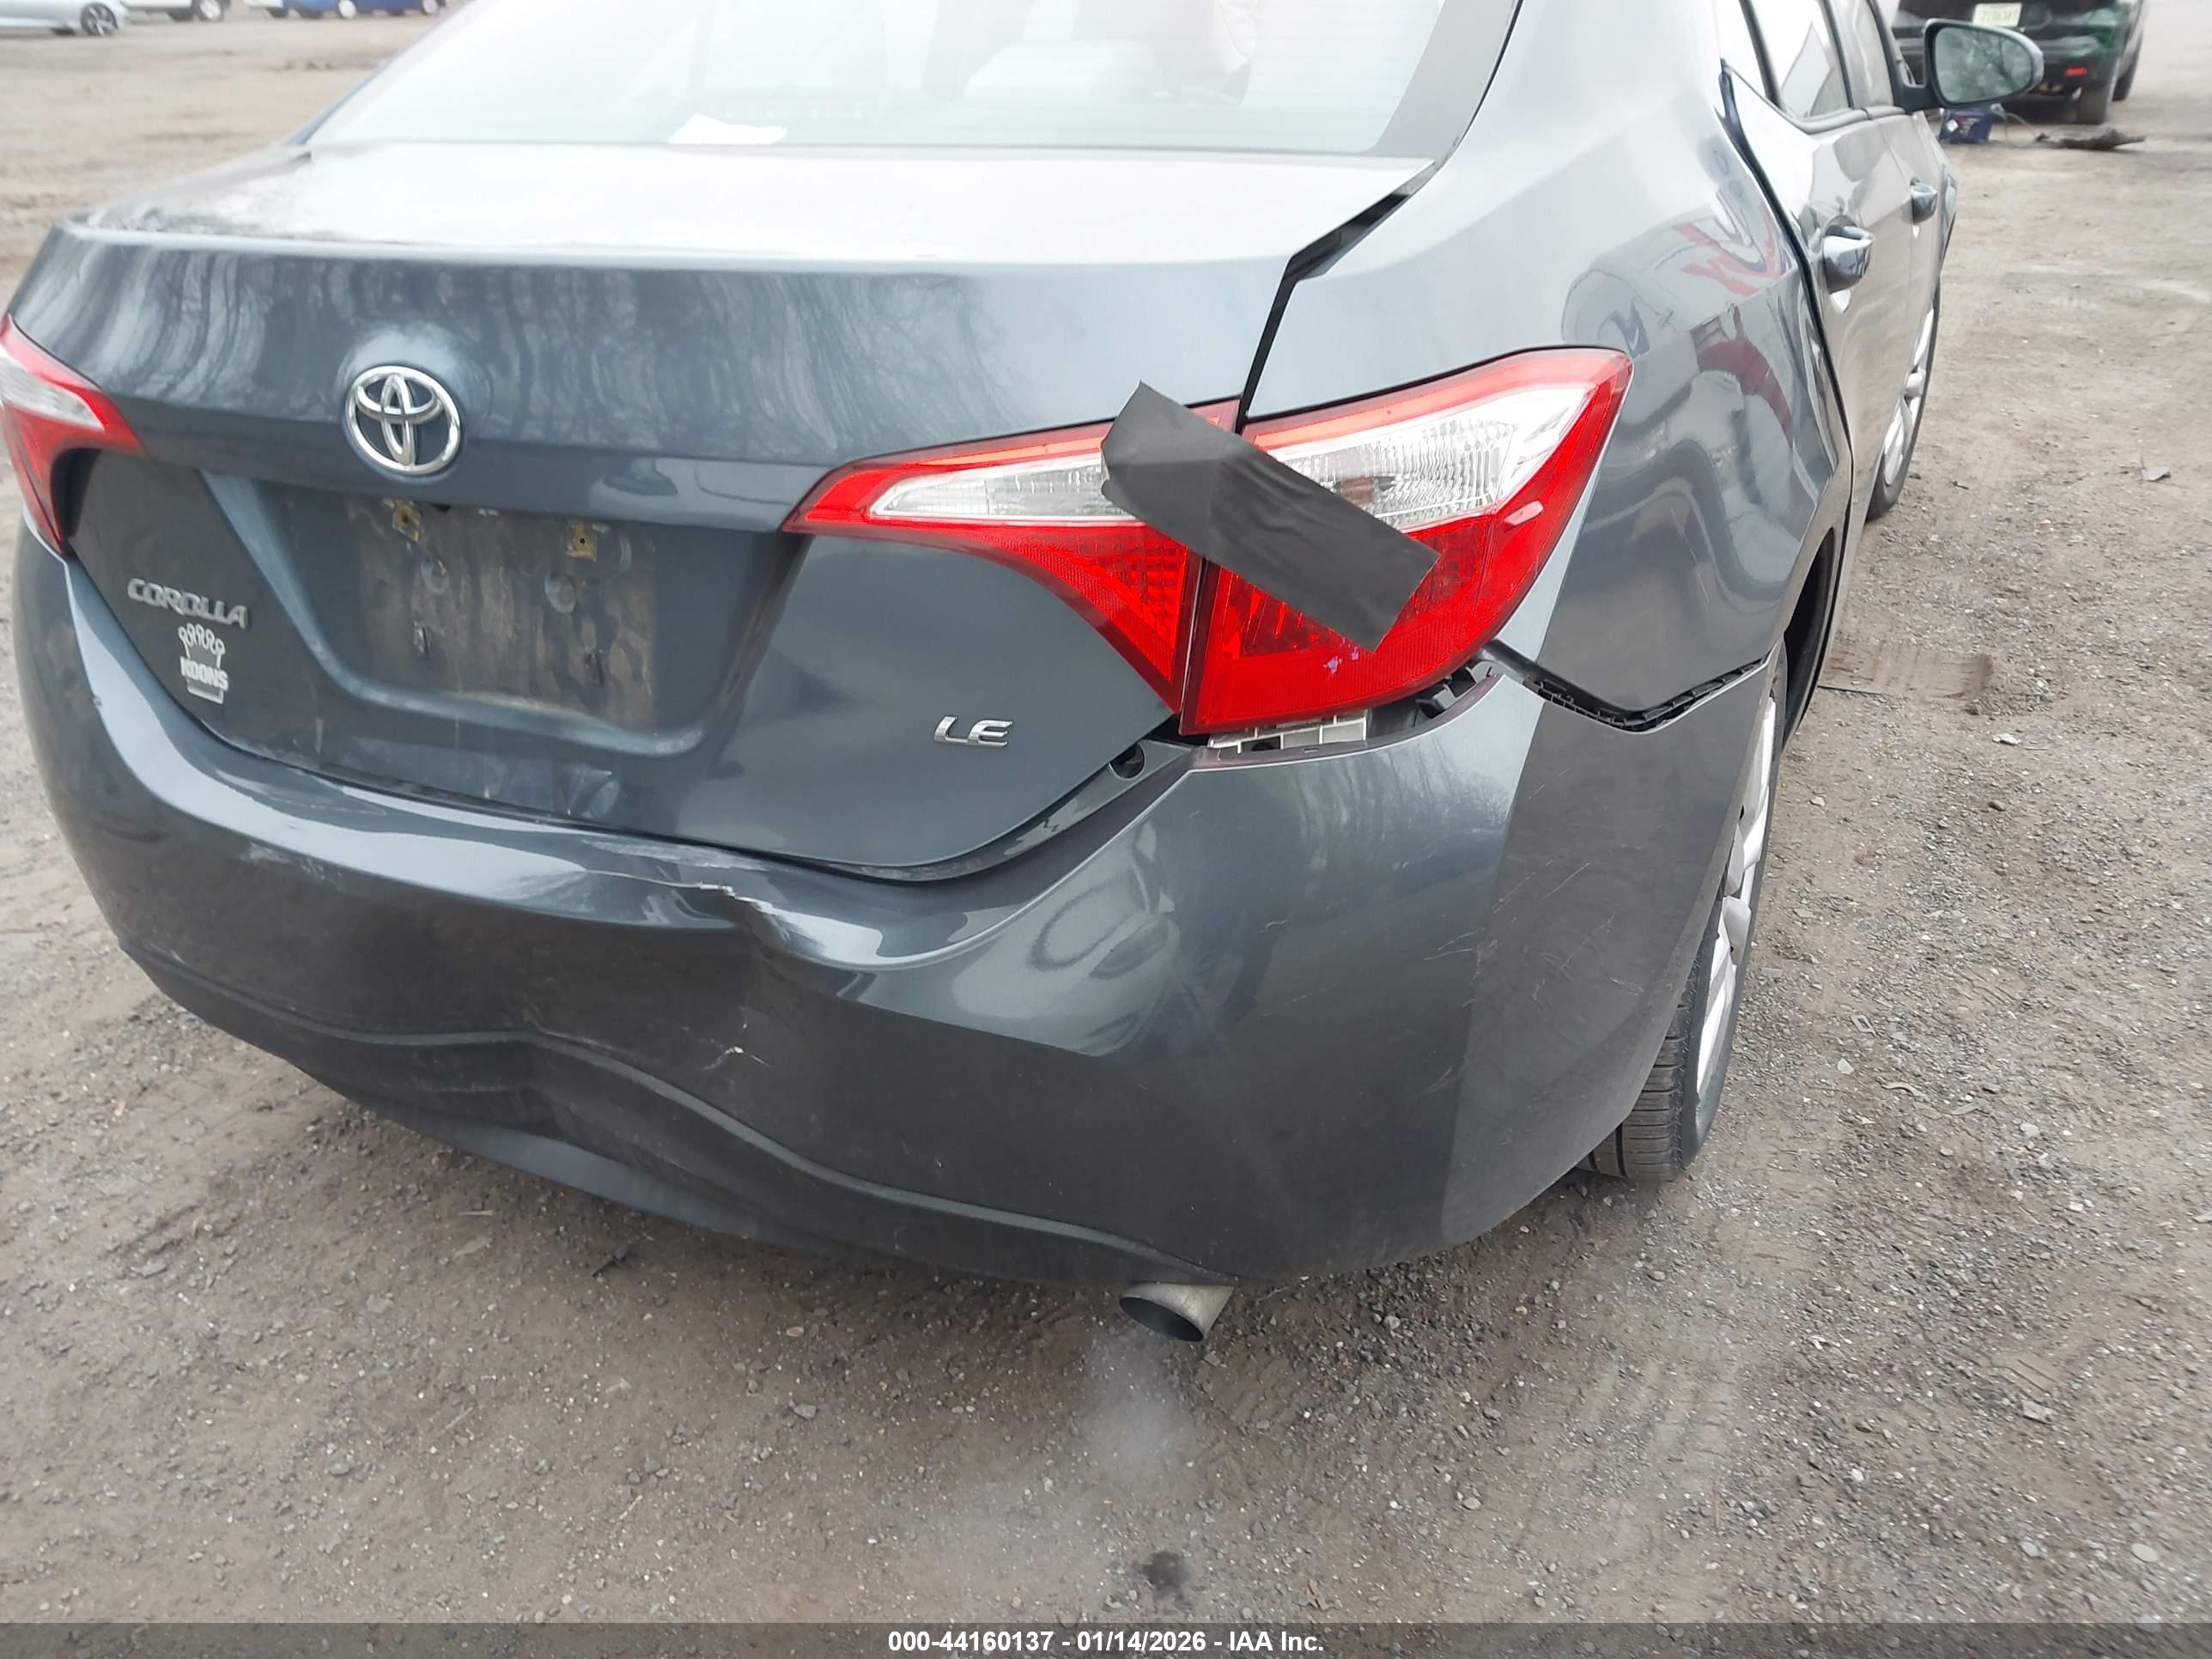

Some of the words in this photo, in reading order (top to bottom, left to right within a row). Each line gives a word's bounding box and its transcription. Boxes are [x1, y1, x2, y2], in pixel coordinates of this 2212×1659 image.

[128, 578, 248, 629] COROLLA
[179, 656, 229, 691] KOONS
[933, 715, 1013, 746] LE
